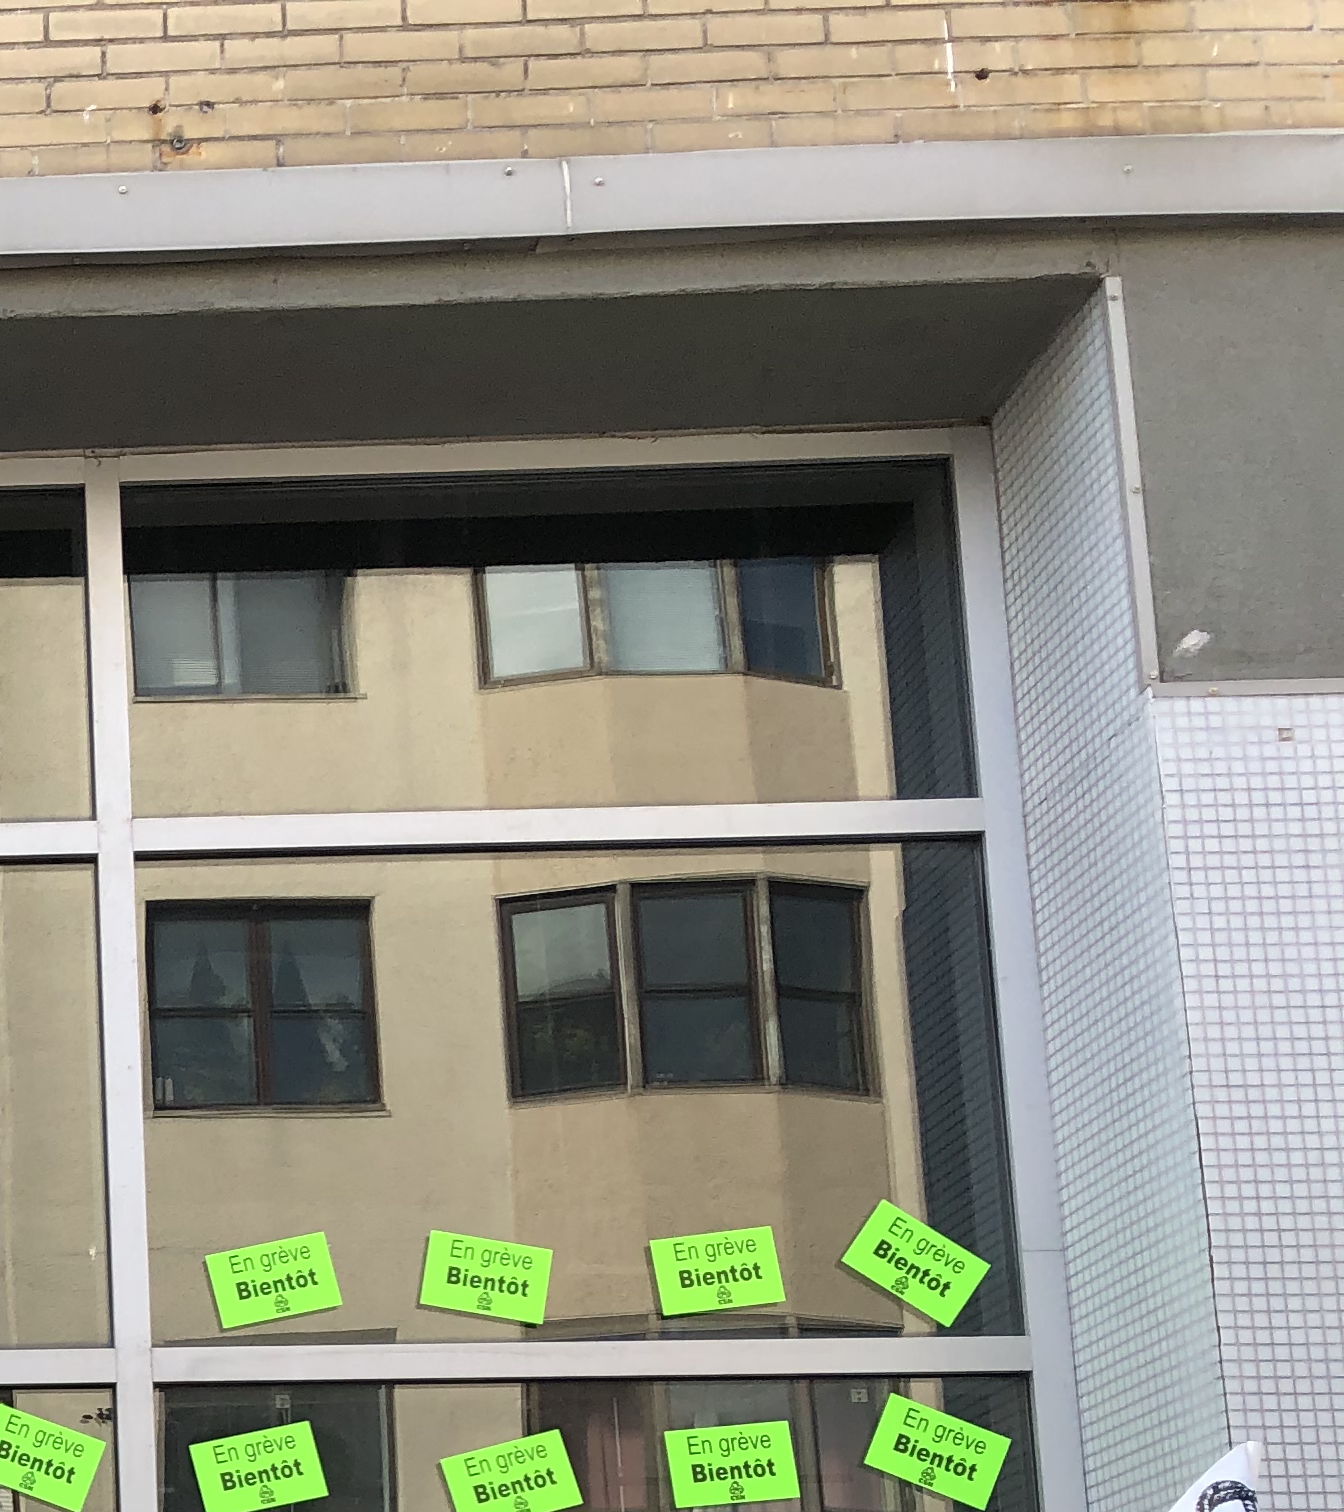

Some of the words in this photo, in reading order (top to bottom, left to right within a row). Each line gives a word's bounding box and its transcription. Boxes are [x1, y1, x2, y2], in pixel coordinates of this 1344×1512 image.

[450, 1239, 474, 1259] En
[481, 1249, 533, 1270] grève
[446, 1265, 529, 1298] Bientôt
[212, 1444, 239, 1465] En
[244, 1435, 296, 1463] grève
[219, 1458, 304, 1492] Bientôt
